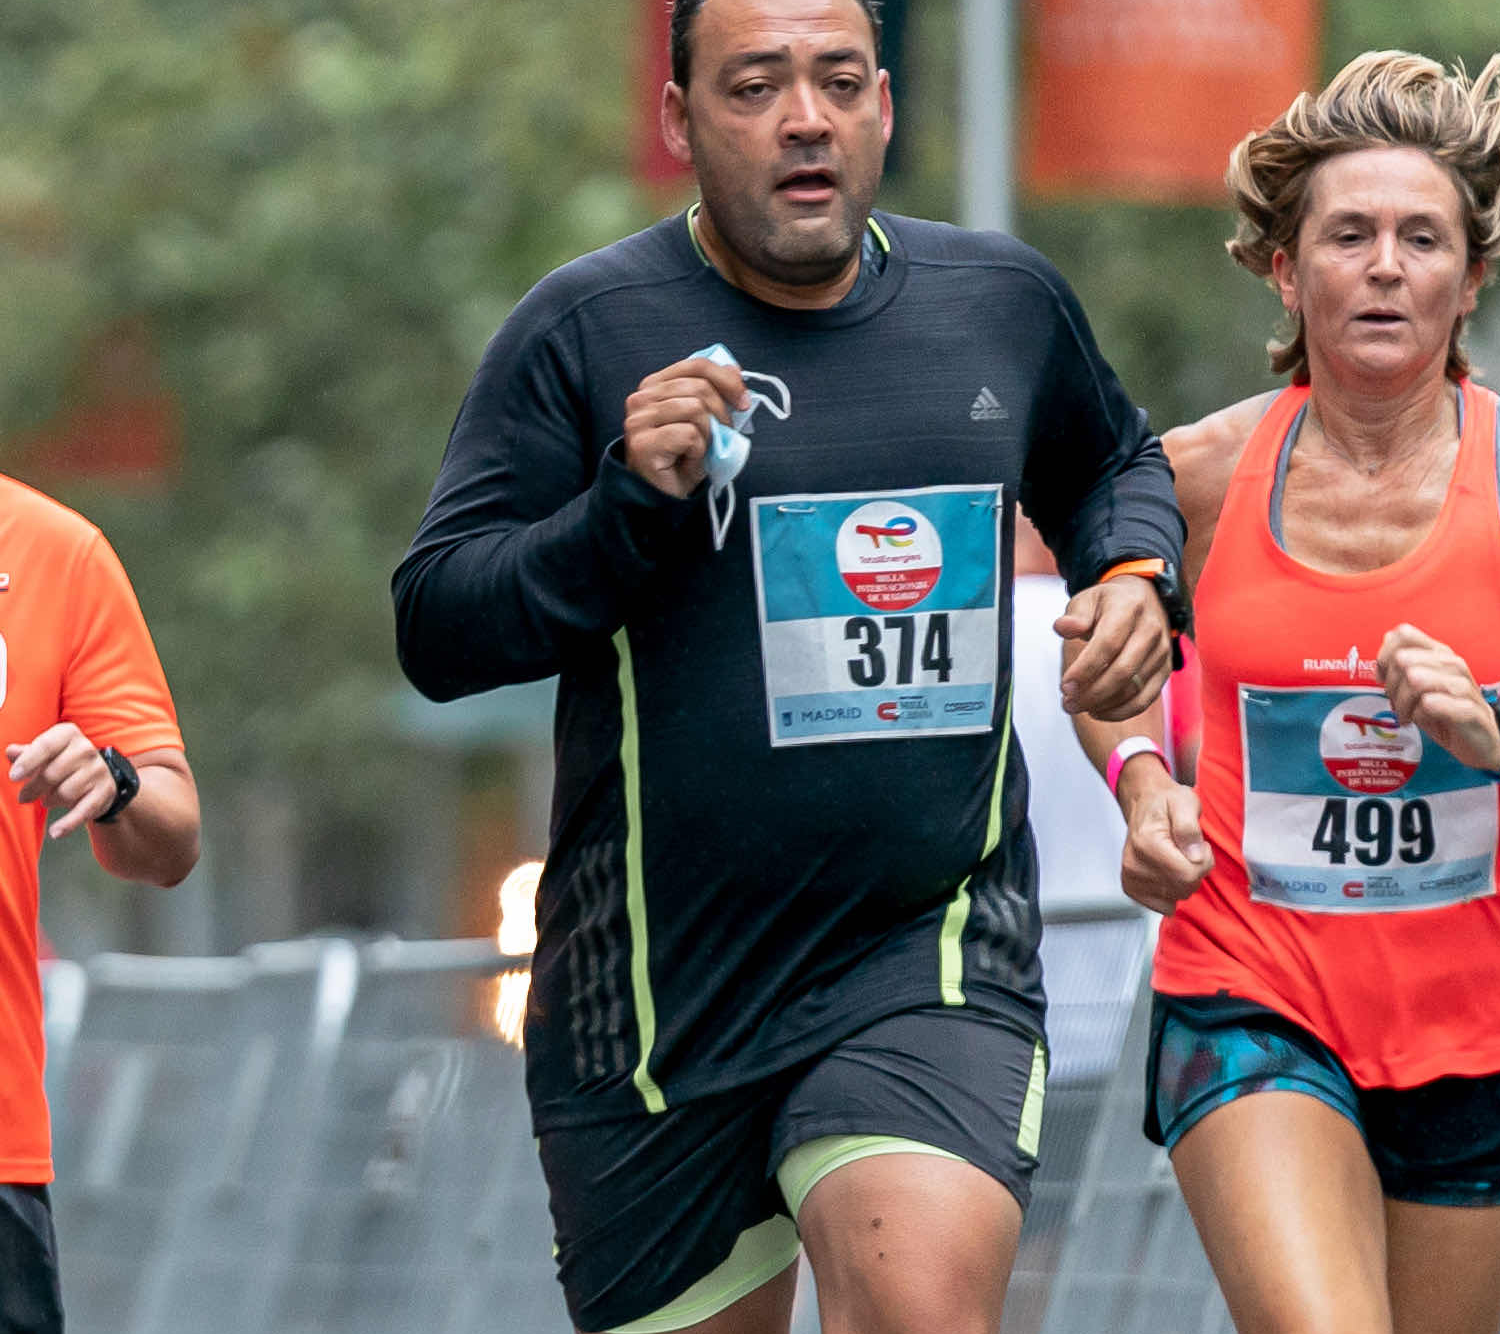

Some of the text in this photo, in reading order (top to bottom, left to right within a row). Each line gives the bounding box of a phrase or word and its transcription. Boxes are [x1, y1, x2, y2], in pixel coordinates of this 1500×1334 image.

[844, 613, 953, 687] 374
[801, 707, 862, 723] MADRID
[1312, 798, 1436, 867] 499
